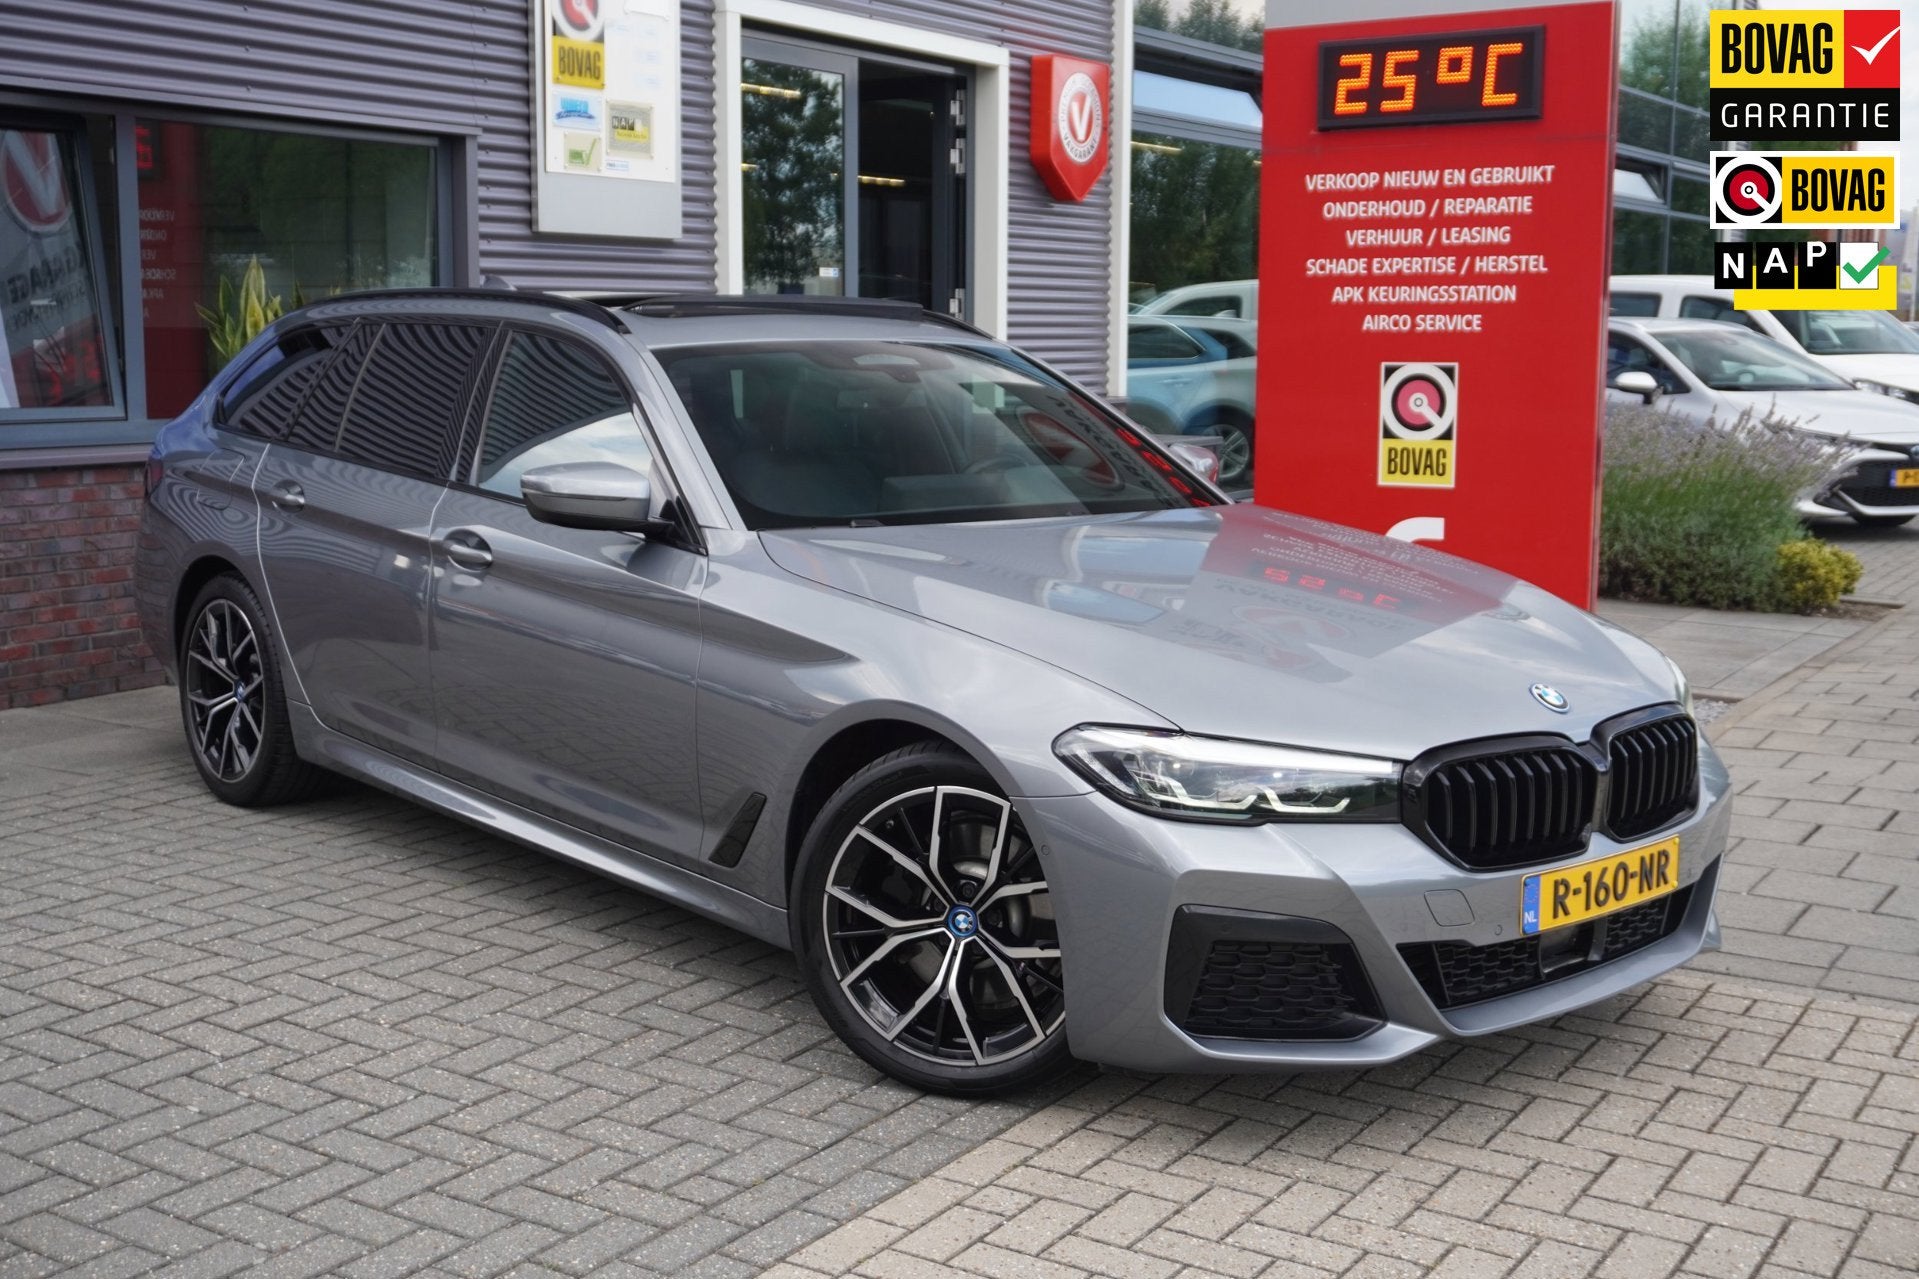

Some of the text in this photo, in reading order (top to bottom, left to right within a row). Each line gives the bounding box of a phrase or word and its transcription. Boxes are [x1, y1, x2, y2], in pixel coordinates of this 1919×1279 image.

[558, 46, 601, 81] BOVAG
[1305, 165, 1555, 191] VERKOOP NIEUW EN GEBRUIKT
[1323, 196, 1533, 219] ONDERHOUD / REPARATIE
[1346, 227, 1511, 246] VERHUUR / LEASING
[1306, 255, 1548, 276] SCHADE EXPERTISE / HERSTEL
[1331, 285, 1517, 304] APK KEURINGSSTATION
[1362, 314, 1482, 332] AIRCO SERVICE
[1388, 447, 1447, 476] BOVAG
[1553, 849, 1670, 919] R-160-NR
[1524, 911, 1537, 924] NL
